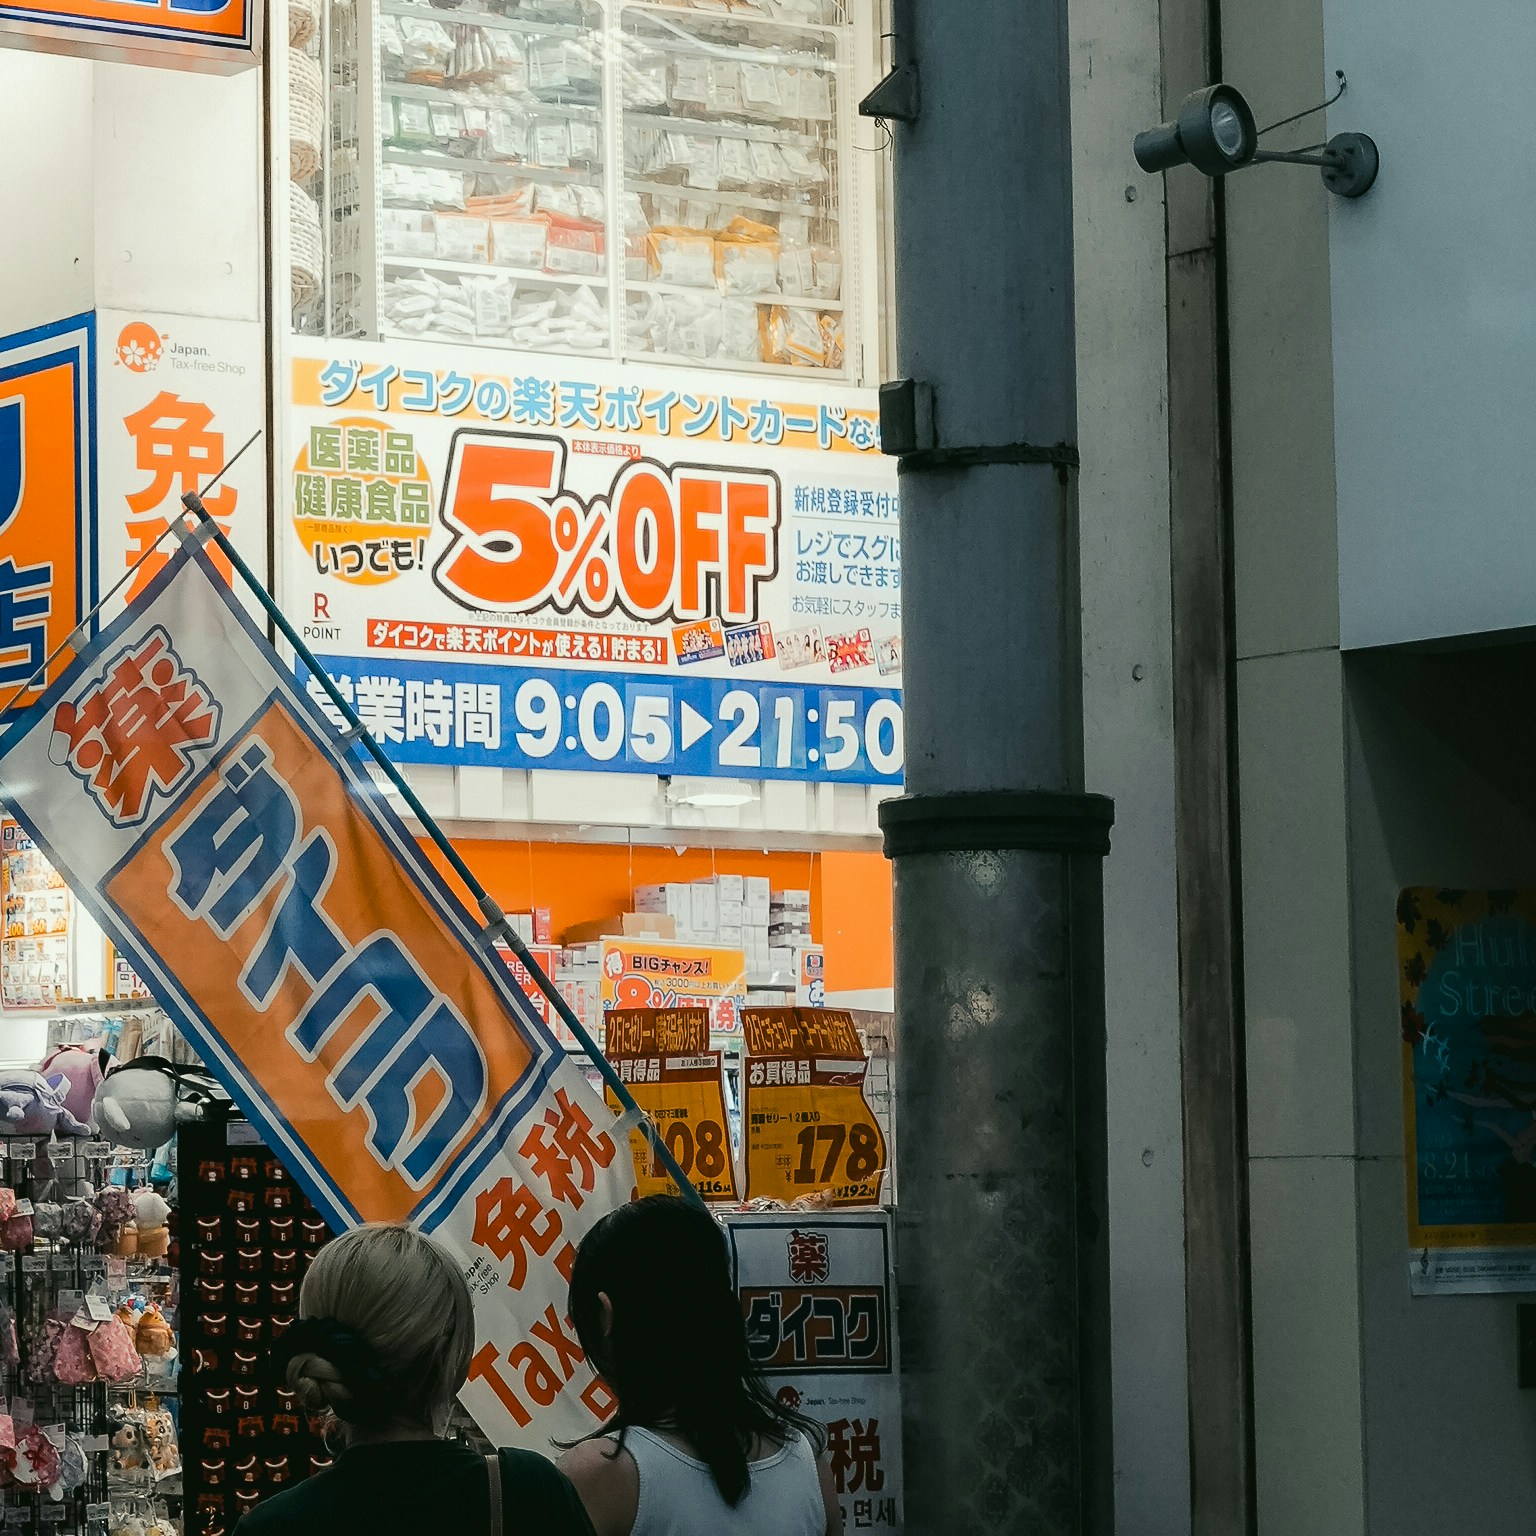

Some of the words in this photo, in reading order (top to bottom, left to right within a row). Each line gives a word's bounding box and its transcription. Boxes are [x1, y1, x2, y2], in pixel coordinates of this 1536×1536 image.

[170, 343, 210, 357] Japan.
[170, 358, 215, 373] Tax-free
[217, 360, 246, 376] Shop
[311, 426, 415, 475] 医薬品
[295, 474, 430, 526] 健康食品
[438, 436, 776, 619] 5%OFF
[315, 540, 425, 576] いつでも!
[303, 626, 341, 640] POINT
[306, 672, 501, 751] 営業時間
[515, 679, 672, 762] 9:05
[718, 690, 904, 775] 21:50
[162, 732, 488, 1188] ダイコク
[632, 955, 709, 975] BIGチャンス!
[750, 1059, 811, 1086] お買得品
[794, 1122, 879, 1184] 178
[472, 1086, 616, 1292] 免税
[480, 1272, 500, 1296] Shop
[745, 1291, 880, 1362] ダイコク
[826, 1417, 885, 1495] 税
[853, 1497, 896, 1528] 면세
